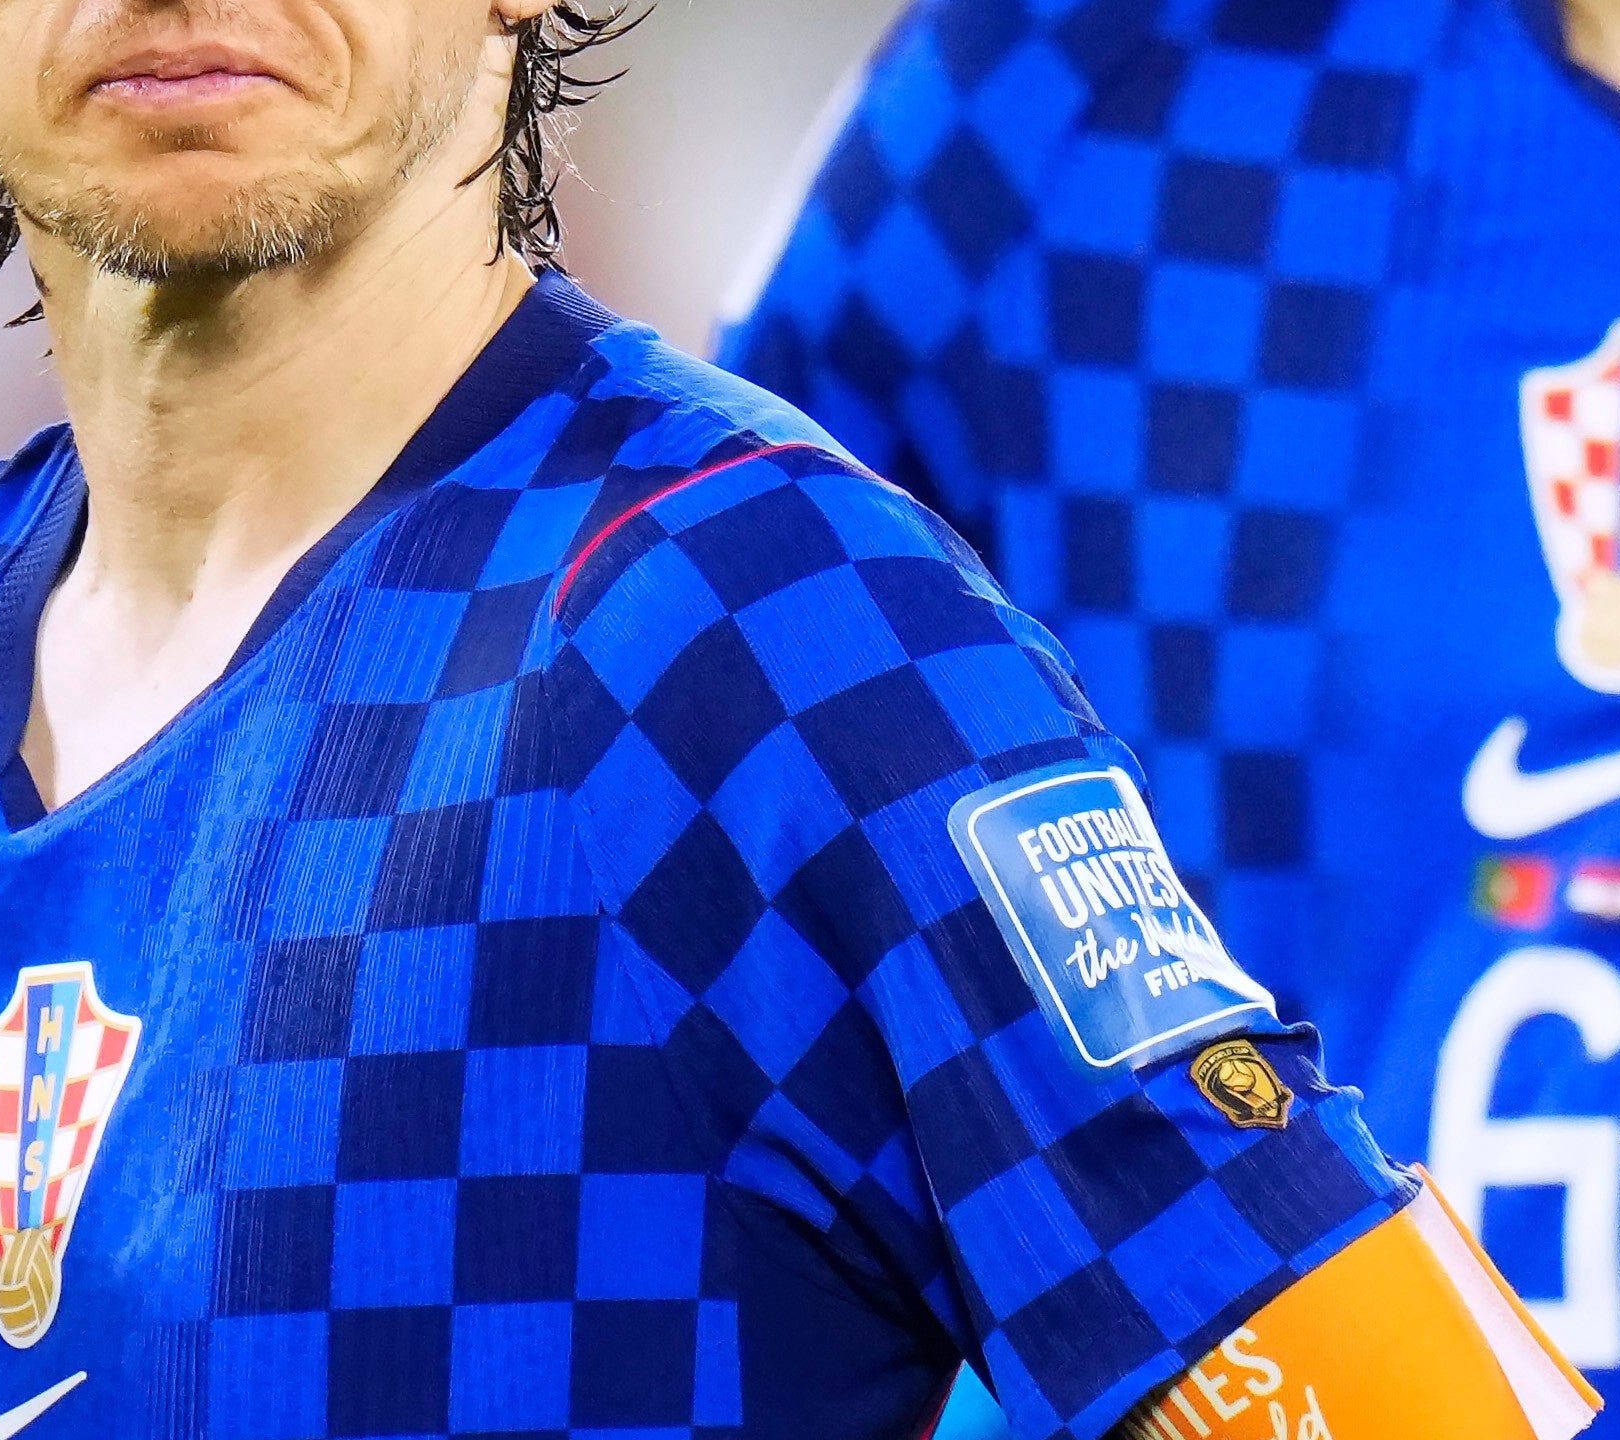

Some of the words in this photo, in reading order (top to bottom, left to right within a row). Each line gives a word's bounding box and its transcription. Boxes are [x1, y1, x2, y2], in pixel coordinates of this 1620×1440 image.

[1040, 851, 1179, 928] UNITES
[1065, 928, 1139, 988] the
[22, 1005, 64, 1192] HNS
